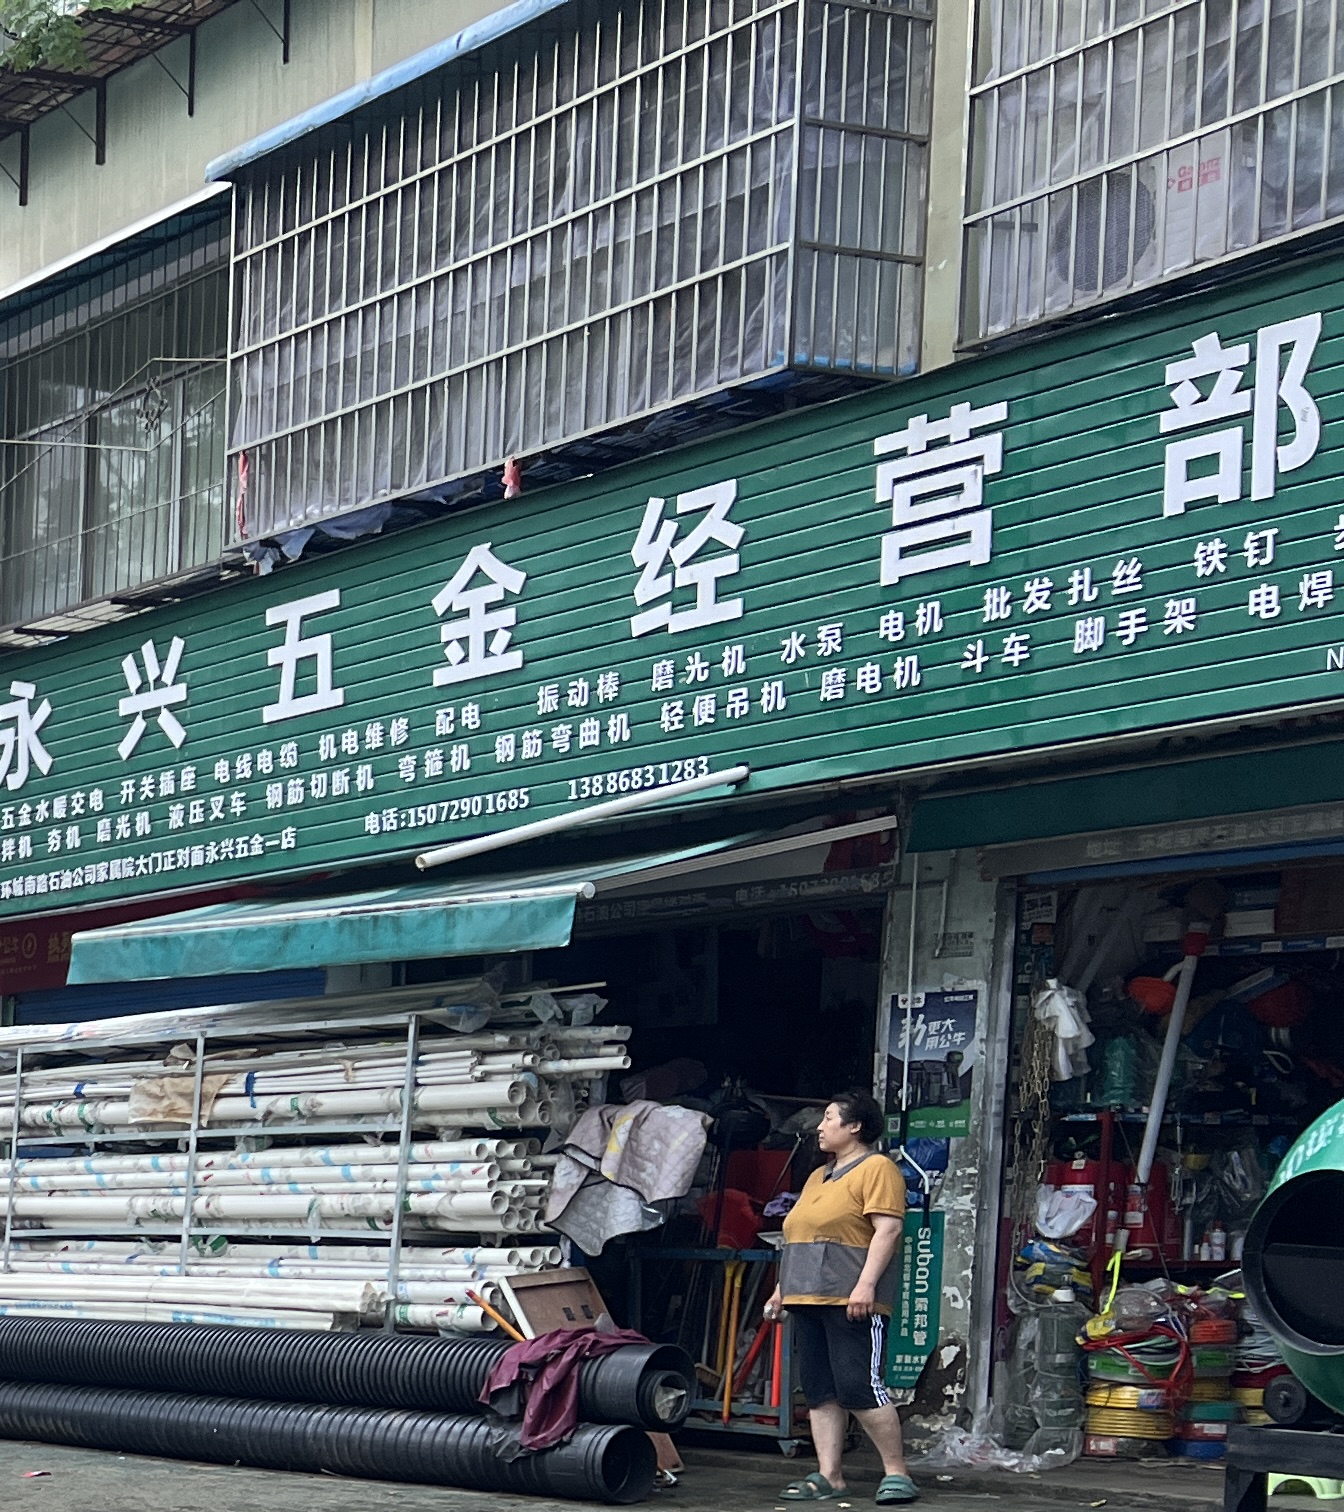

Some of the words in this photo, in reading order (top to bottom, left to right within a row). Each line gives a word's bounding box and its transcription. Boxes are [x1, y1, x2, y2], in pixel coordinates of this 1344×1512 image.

[0, 788, 105, 830] 五金水暖交电
[120, 765, 198, 804] 开关插座
[214, 741, 299, 784] 电线电缆
[318, 717, 410, 761] 机电维修
[434, 702, 482, 737] 配电
[536, 672, 622, 717] 振动棒
[651, 645, 748, 693] 磨光机
[780, 622, 844, 665] 水泵
[878, 600, 945, 643] 电机
[982, 556, 1144, 623] 批发扎丝
[1193, 527, 1280, 578] 铁钉
[47, 825, 82, 853] 夯机
[96, 811, 152, 843] 磨光机
[168, 790, 248, 830] 液压叉车
[266, 764, 376, 811] 钢筋切断机
[398, 743, 472, 783] 弯箍机
[495, 713, 632, 763] 钢筋弯曲机
[660, 680, 788, 734] 轻便吊机
[819, 655, 923, 703] 磨电机
[960, 631, 1032, 675] 斗车
[1073, 597, 1199, 655] 脚手架
[1247, 569, 1335, 620] 电焊
[567, 756, 710, 801] 13886831283
[915, 1227, 935, 1293] suban
